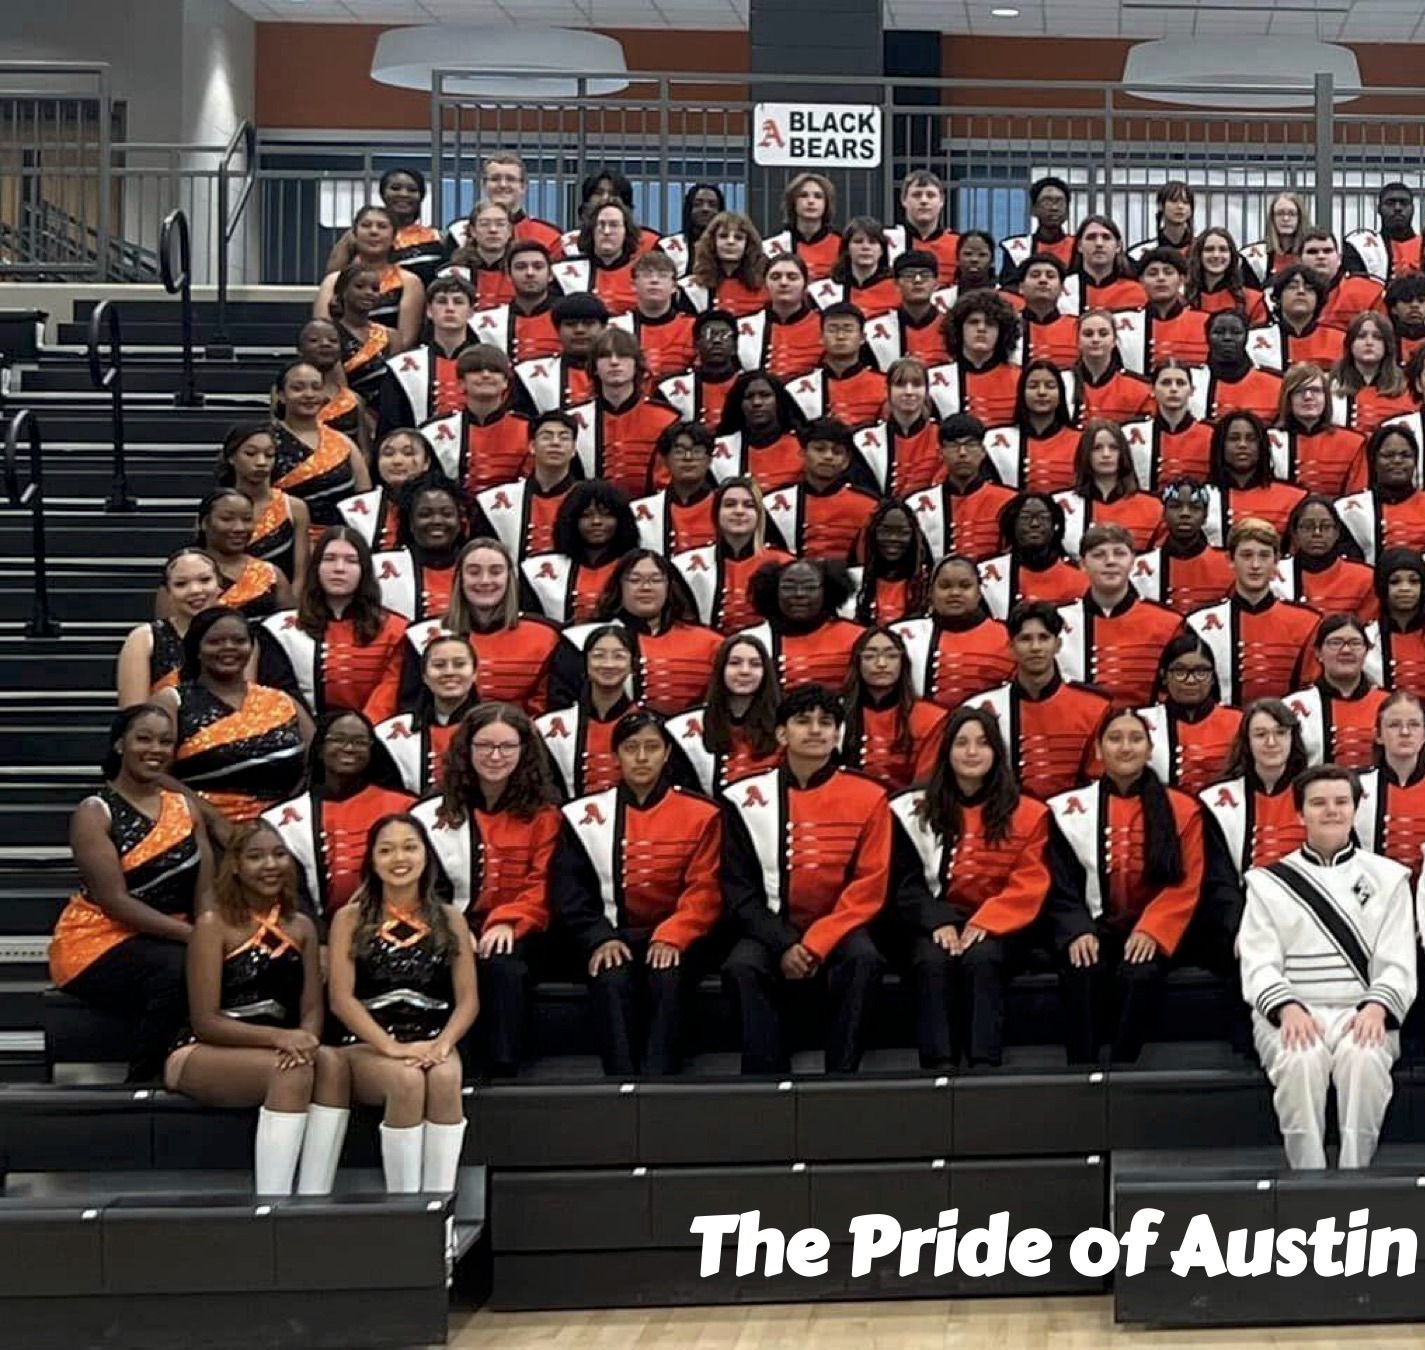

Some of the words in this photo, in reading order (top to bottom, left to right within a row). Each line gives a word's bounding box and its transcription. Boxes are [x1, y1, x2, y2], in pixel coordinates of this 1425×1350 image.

[789, 111, 876, 134] BLACK
[758, 118, 785, 148] A
[789, 137, 875, 160] BEARS
[669, 380, 690, 396] A
[434, 424, 456, 441] A
[348, 499, 370, 515] A
[490, 492, 512, 511] A
[770, 494, 792, 511] A
[378, 561, 400, 580] A
[535, 562, 558, 580] A
[686, 554, 709, 571] A
[1133, 560, 1154, 577] A
[1201, 613, 1224, 631] A
[388, 721, 412, 739] A
[546, 717, 571, 738] A
[682, 718, 704, 738] A
[741, 785, 768, 808] A
[1062, 797, 1086, 815] A
[1214, 787, 1239, 808] A
[278, 807, 303, 827] A
[579, 803, 606, 825] A
